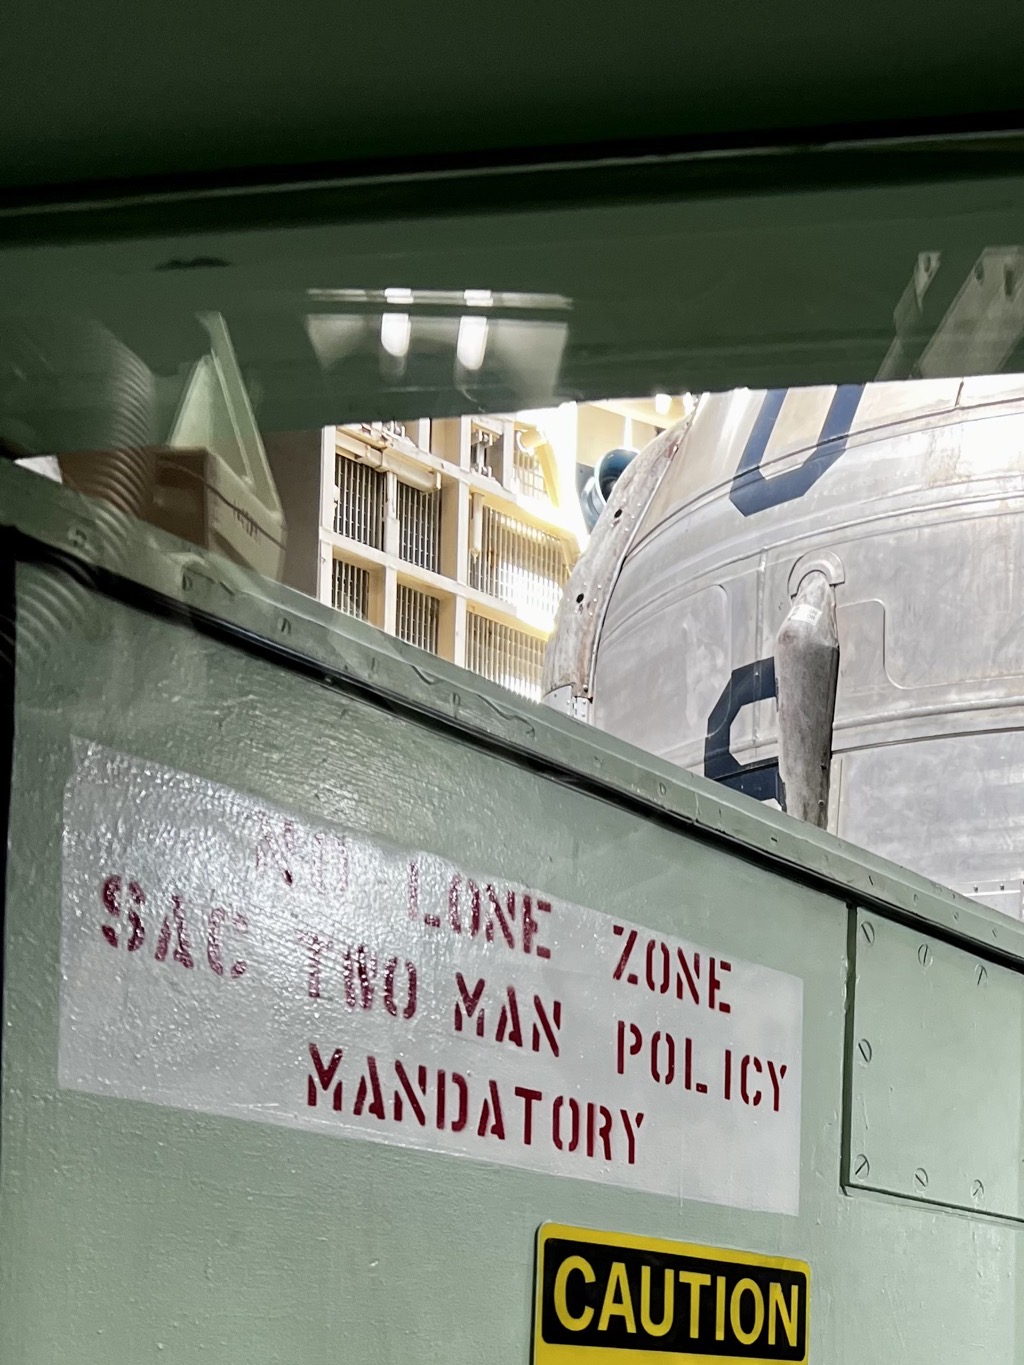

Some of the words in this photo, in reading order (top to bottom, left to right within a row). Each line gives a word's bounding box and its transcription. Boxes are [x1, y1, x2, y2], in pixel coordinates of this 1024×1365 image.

[101, 875, 248, 979] SAC
[302, 931, 418, 1020] TWO
[454, 972, 561, 1058] MAN
[616, 1020, 788, 1112] POLICY
[409, 861, 551, 960] LONE
[612, 925, 732, 1014] ZONE
[307, 1042, 645, 1165] MANDATORY
[554, 1255, 798, 1347] CAUTION
